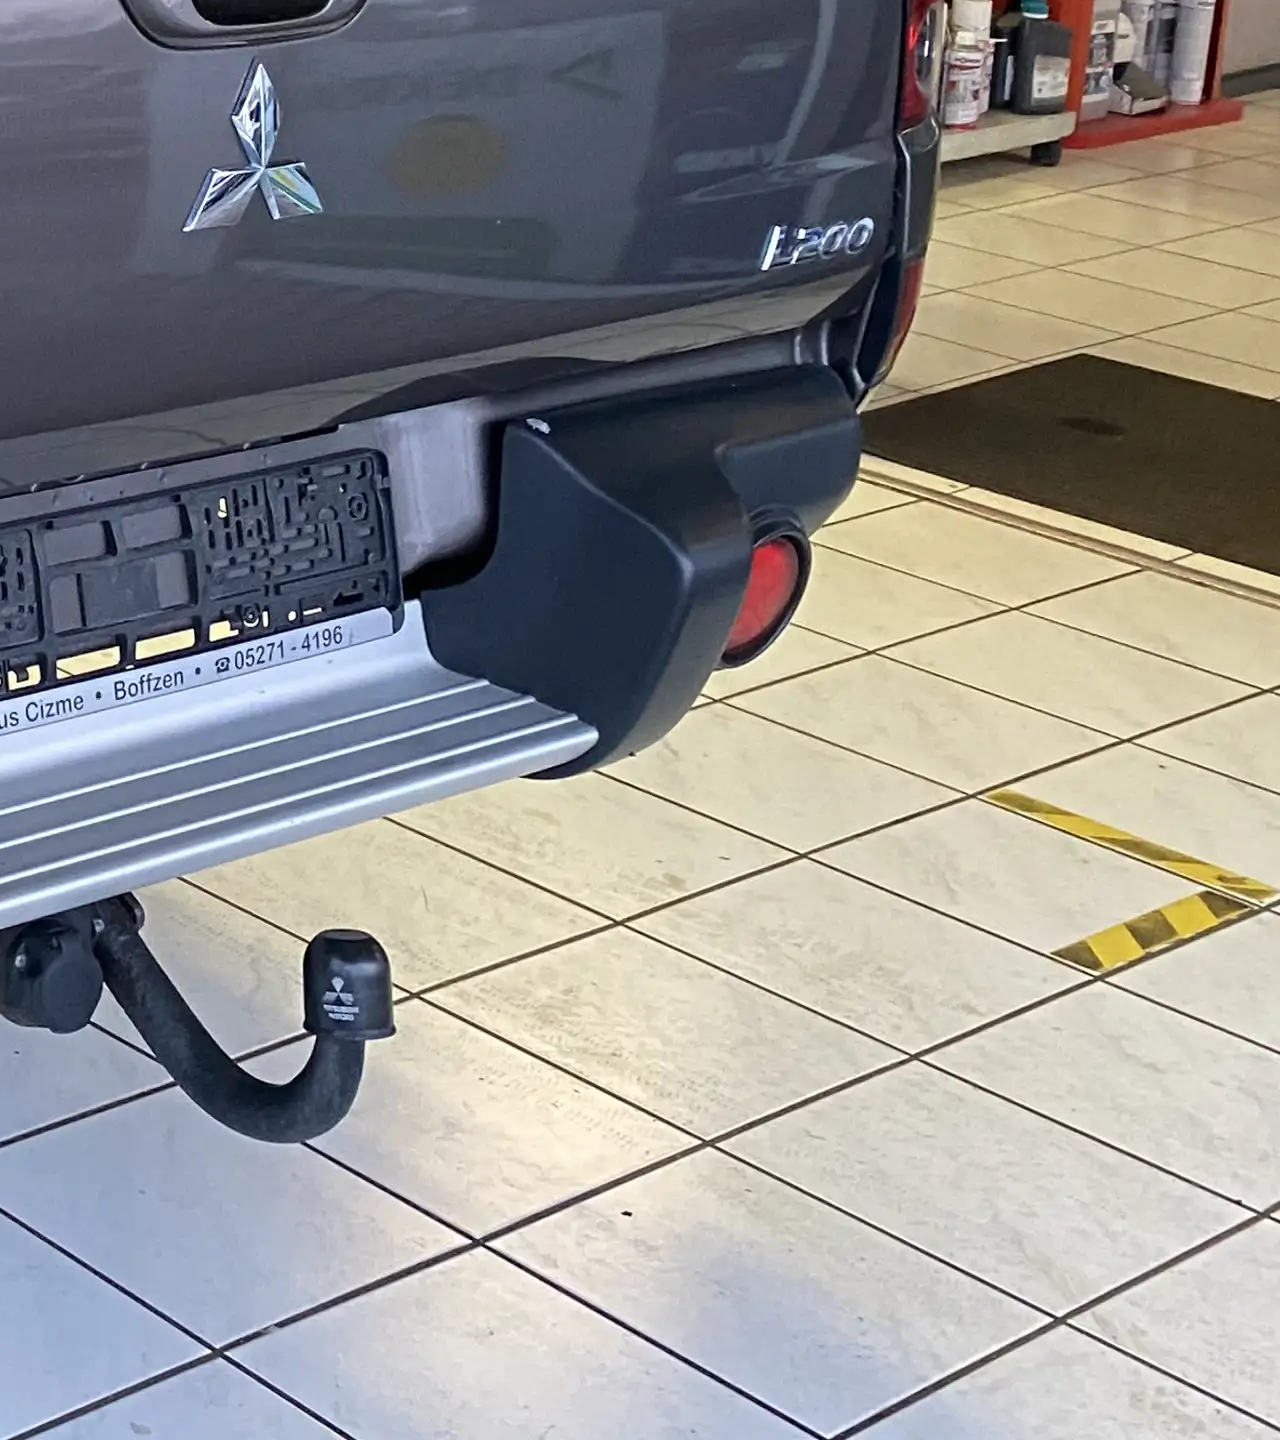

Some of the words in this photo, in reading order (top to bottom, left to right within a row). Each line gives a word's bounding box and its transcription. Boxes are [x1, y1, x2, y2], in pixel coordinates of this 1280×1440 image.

[759, 216, 875, 271] L200
[25, 694, 84, 722] Cizme
[113, 671, 185, 701] Boffzen
[234, 640, 285, 670] 05271
[301, 625, 343, 654] 4196
